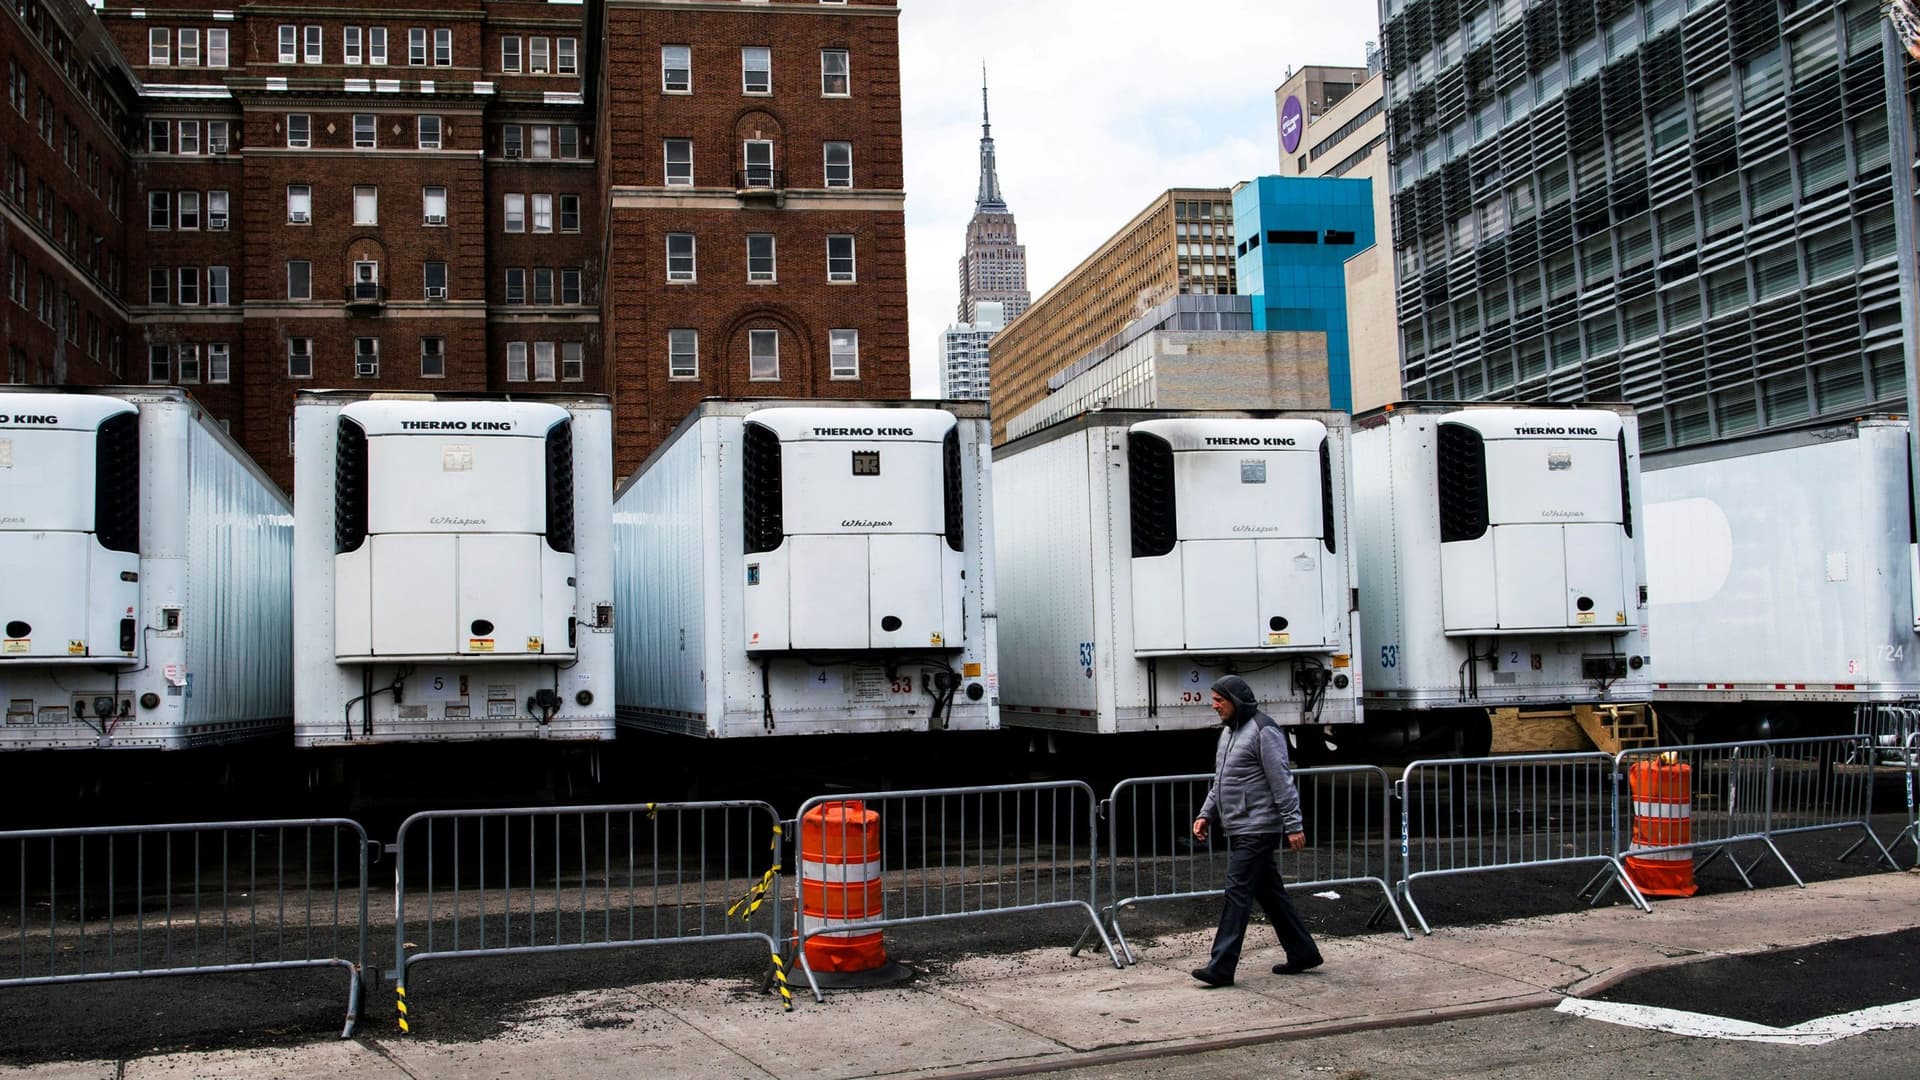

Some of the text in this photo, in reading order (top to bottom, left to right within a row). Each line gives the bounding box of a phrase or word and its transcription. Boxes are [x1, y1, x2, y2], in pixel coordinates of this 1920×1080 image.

[14, 415, 58, 425] KING
[401, 421, 511, 431] THERMO KING
[1513, 427, 1598, 435] THERMO KING
[813, 427, 914, 436] THERMO KING
[1205, 437, 1296, 446] THERMO KING
[429, 516, 487, 527] Whisper
[841, 519, 893, 529] Whisper
[1511, 651, 1519, 664] 2
[818, 671, 827, 684] 4
[1191, 670, 1200, 683] 3
[434, 676, 444, 690] 5
[891, 677, 912, 694] 53
